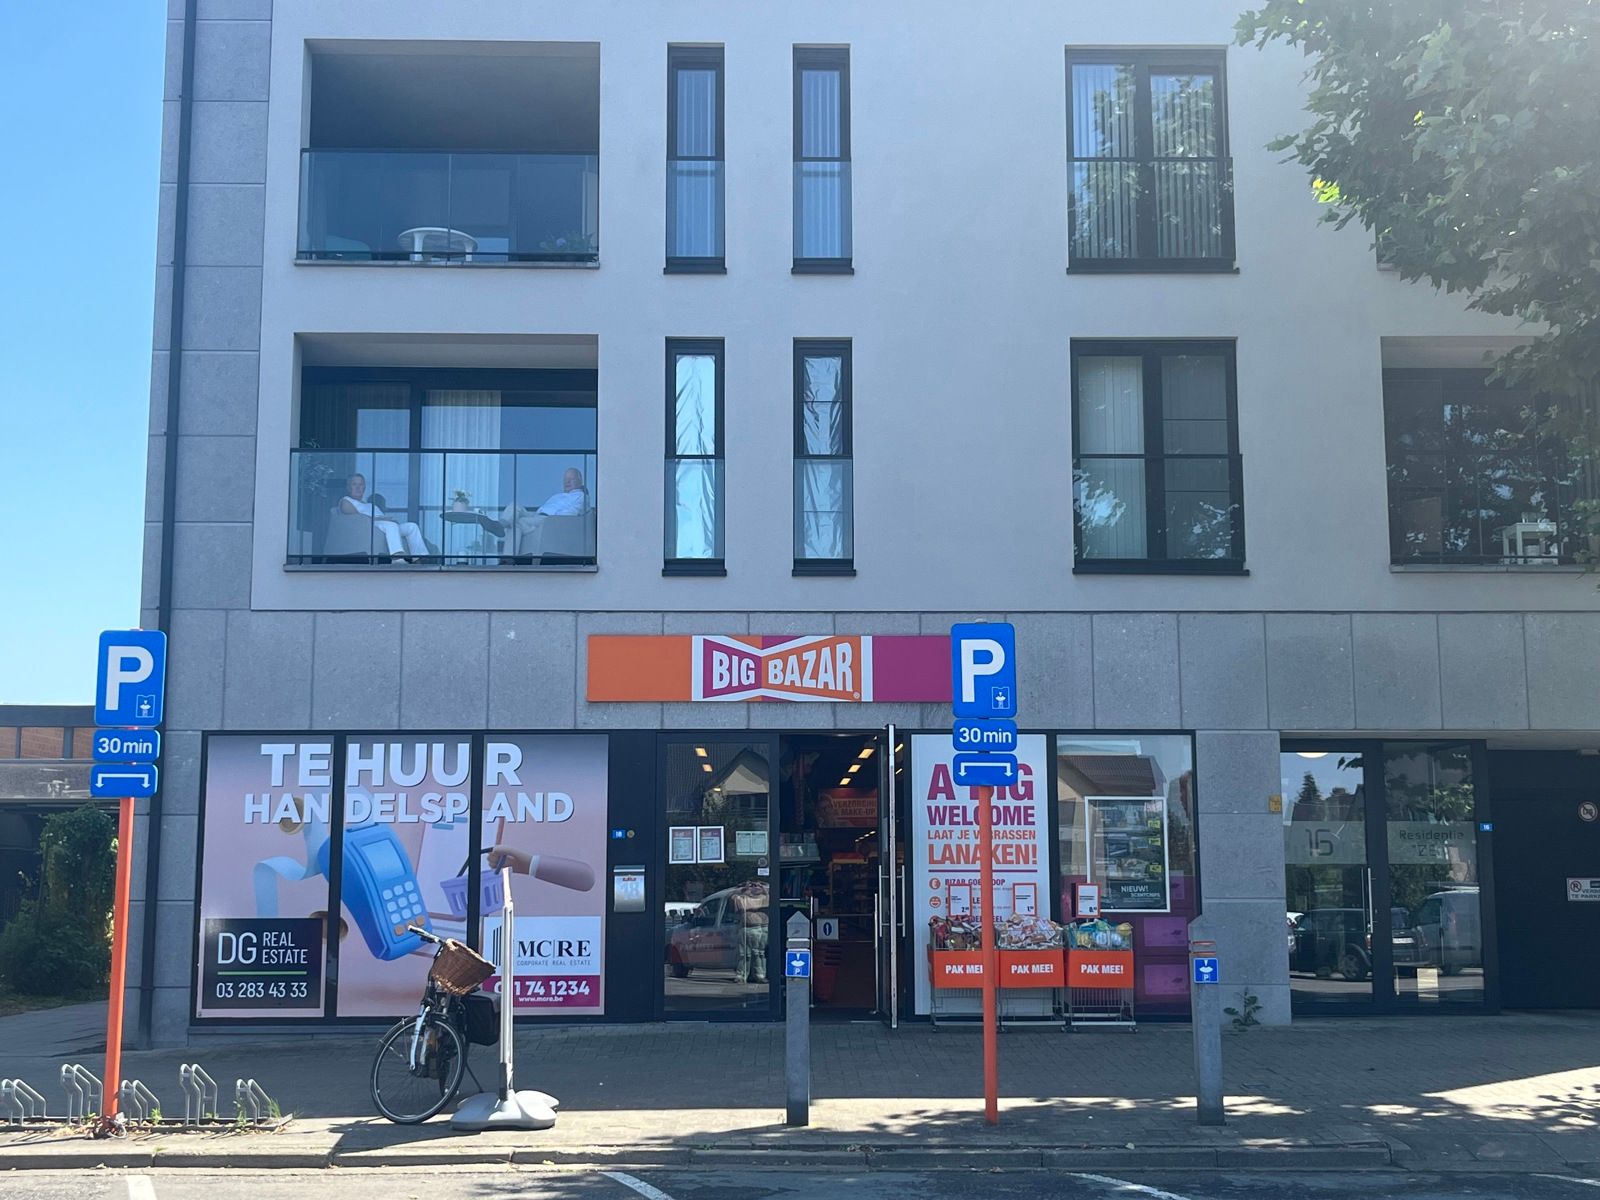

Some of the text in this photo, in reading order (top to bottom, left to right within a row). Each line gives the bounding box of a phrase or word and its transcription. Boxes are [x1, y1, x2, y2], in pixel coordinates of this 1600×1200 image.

[712, 642, 853, 692] BIG BAZAR
[960, 638, 1005, 703] P
[105, 645, 154, 711] P
[959, 727, 1012, 743] 30 min
[97, 737, 153, 754] 30 min
[261, 743, 523, 787] TE HUUR
[926, 763, 956, 801] A
[244, 791, 575, 824] HANDELSPAND
[928, 829, 1036, 840] LAAT JE VRASSEN
[1305, 828, 1334, 857] 16
[1399, 829, 1464, 840] Residentie
[1120, 885, 1149, 893] NIEUW!
[217, 931, 295, 964] DG REAL
[262, 949, 308, 964] ESTATE
[516, 959, 591, 967] CORPORATE REAL ESTATE
[945, 964, 964, 974] PAK
[1011, 963, 1054, 974] PAK MEE!
[1080, 964, 1124, 975] PAK MEE!
[216, 982, 308, 998] 03 283 43 33
[525, 980, 546, 996] 74
[549, 980, 590, 996] 1234
